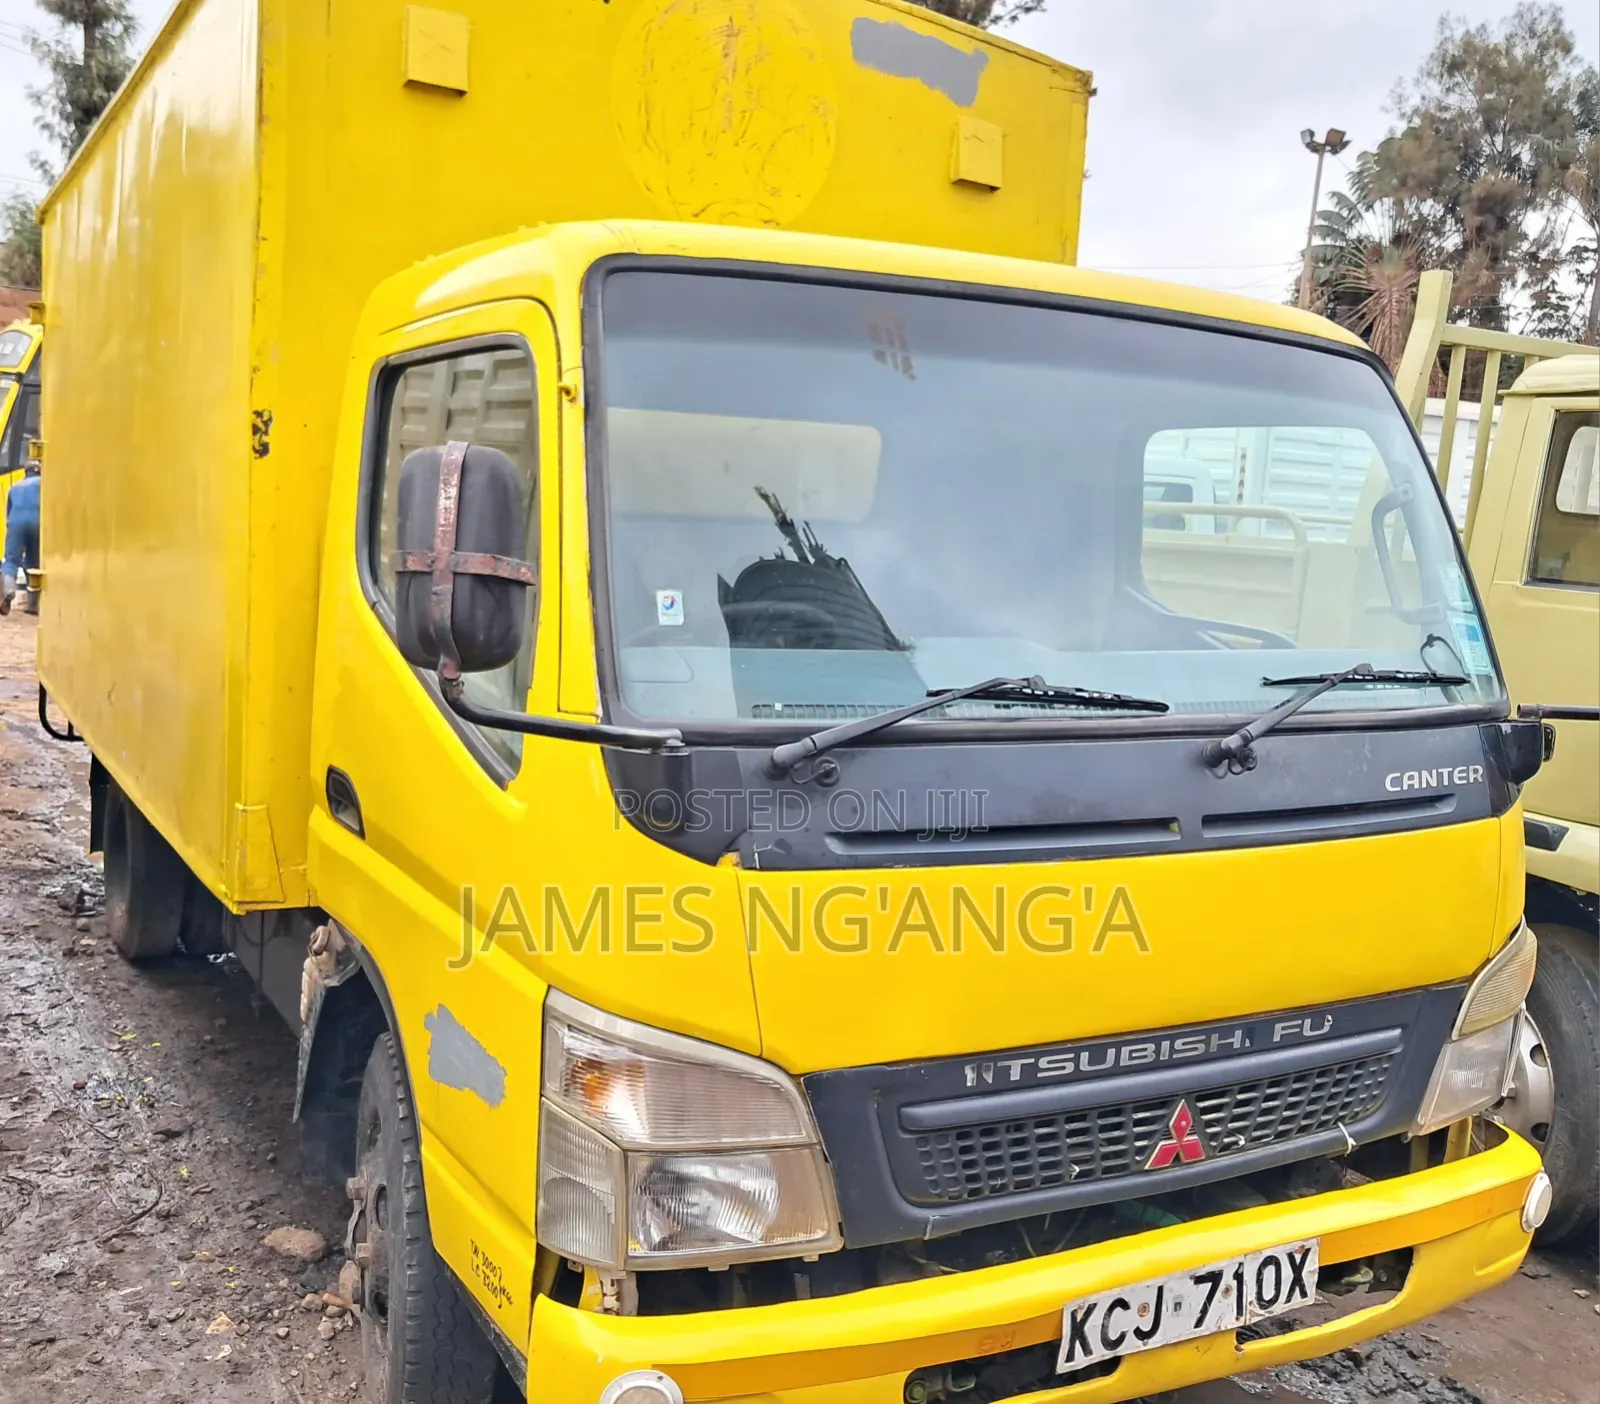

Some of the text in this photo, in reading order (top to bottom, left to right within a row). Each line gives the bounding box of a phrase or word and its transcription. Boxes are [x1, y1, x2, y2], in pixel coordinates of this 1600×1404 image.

[1384, 764, 1484, 792] CANTER
[1063, 1246, 1312, 1364] KCJ 710X
